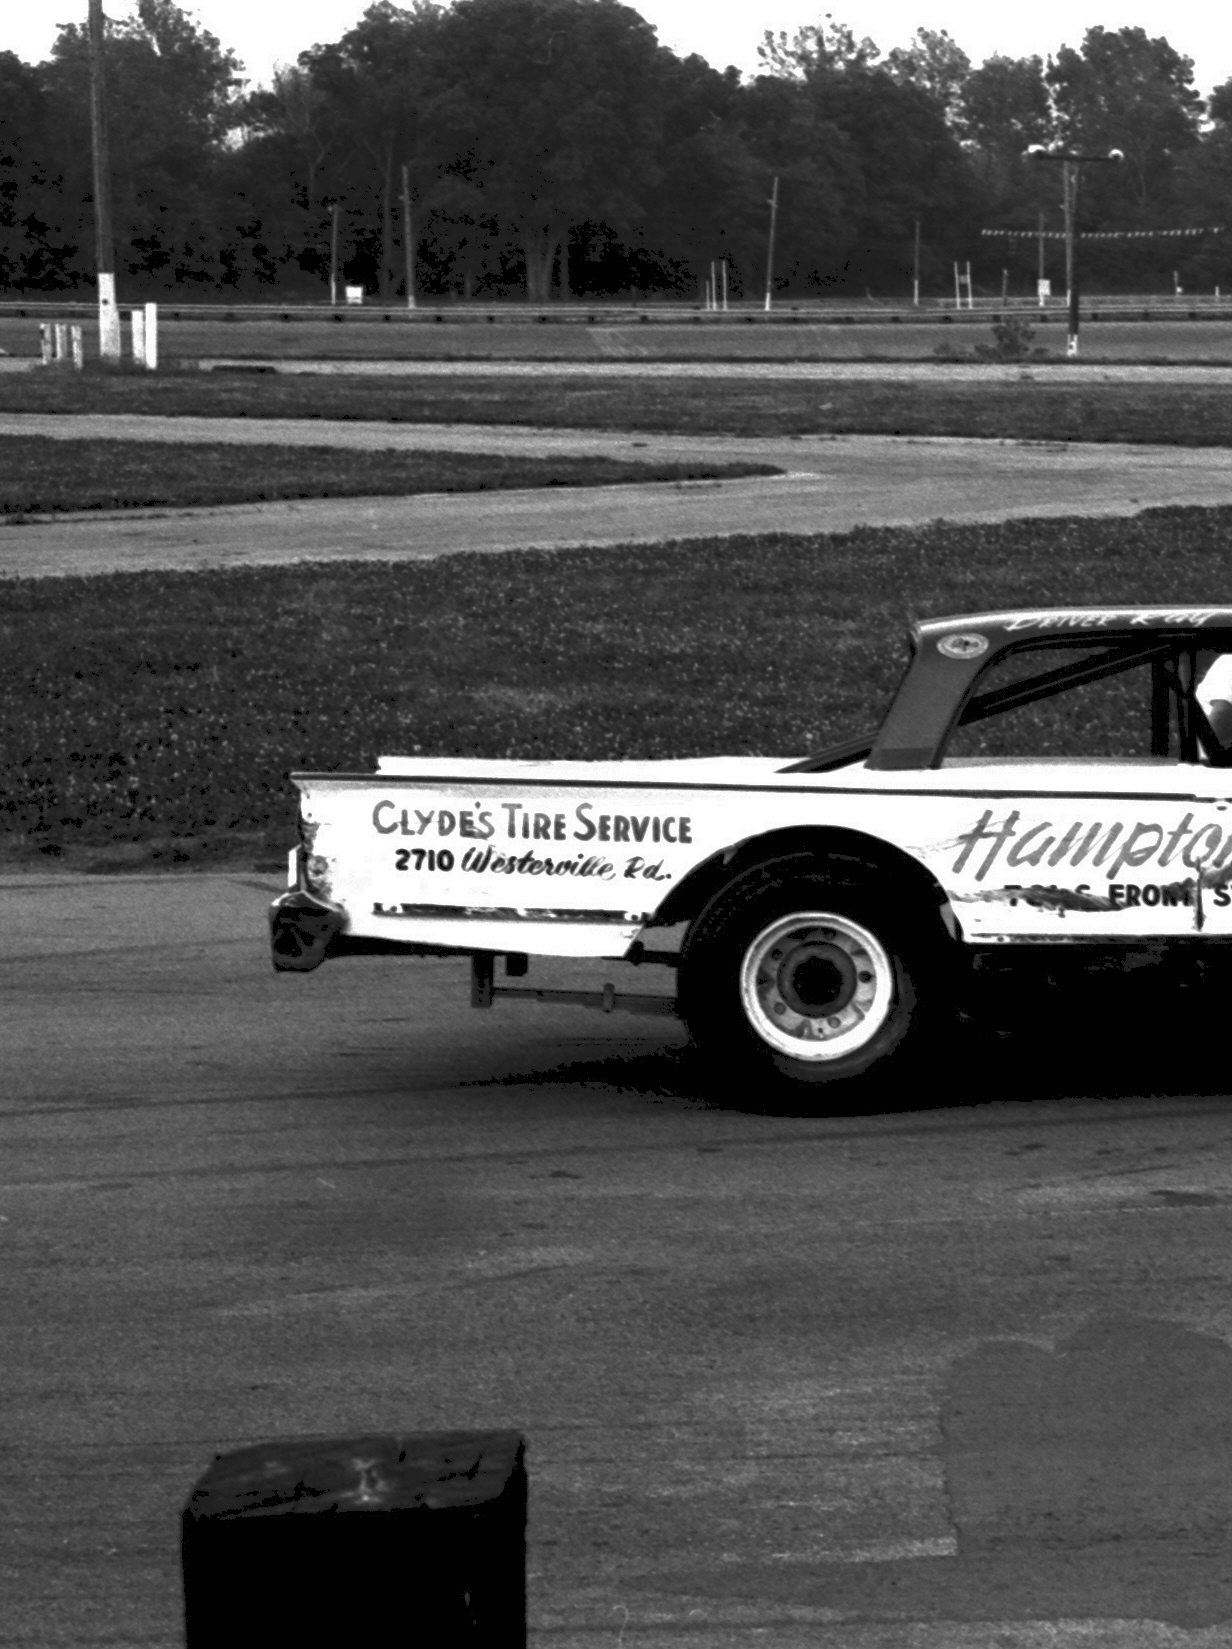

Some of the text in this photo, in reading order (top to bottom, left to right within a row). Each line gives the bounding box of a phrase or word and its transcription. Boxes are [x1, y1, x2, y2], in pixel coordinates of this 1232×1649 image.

[372, 799, 692, 844] CLYDE'S TIRE SERVICE
[395, 848, 455, 872] 2710
[623, 856, 672, 882] Rd.
